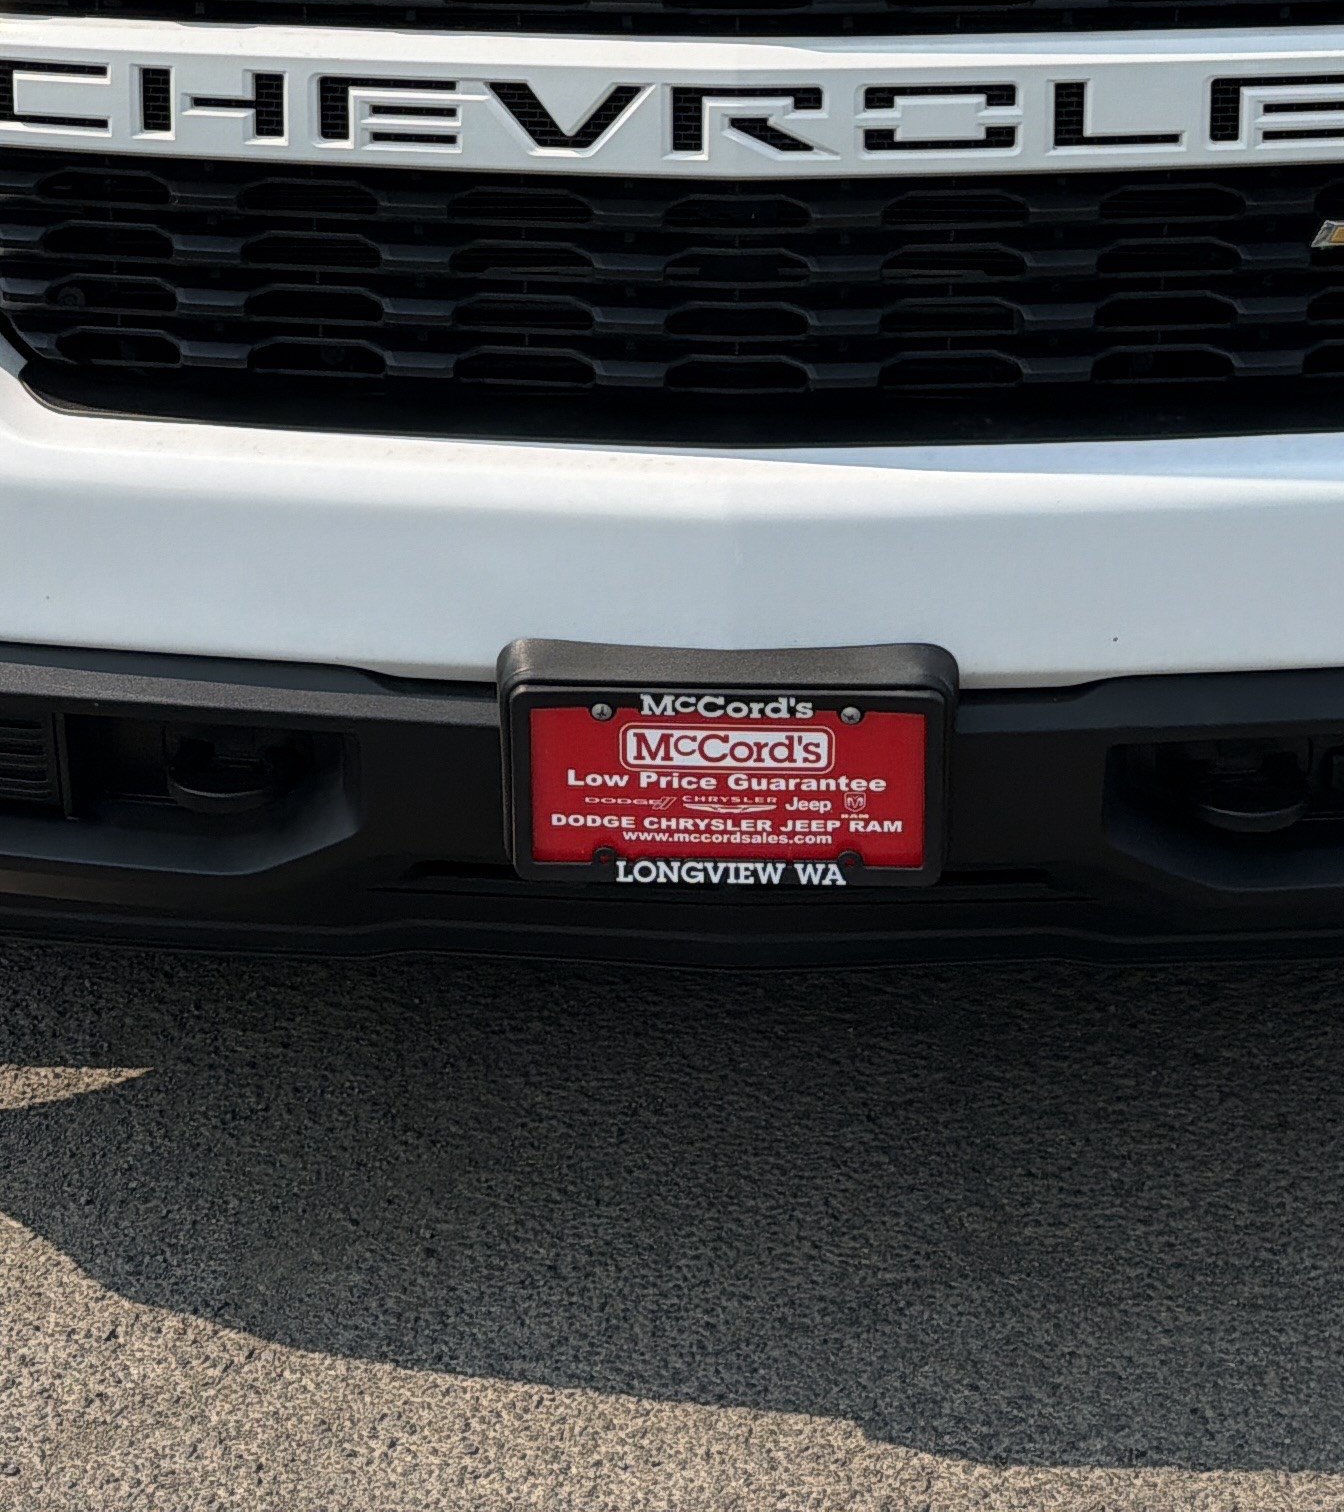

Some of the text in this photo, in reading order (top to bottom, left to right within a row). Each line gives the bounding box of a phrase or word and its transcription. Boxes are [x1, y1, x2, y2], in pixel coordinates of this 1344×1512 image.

[640, 693, 814, 719] McCord's
[632, 732, 822, 764] McCord's
[567, 769, 887, 792] Low Price Guarantee
[682, 794, 777, 804] CHRYSLER
[785, 796, 832, 814] Jeep
[551, 813, 903, 833] DODGE CHRYSLER JEEP RAM
[622, 830, 833, 845] www.mccordsales.com
[615, 860, 847, 886] LONGVIEW WA
